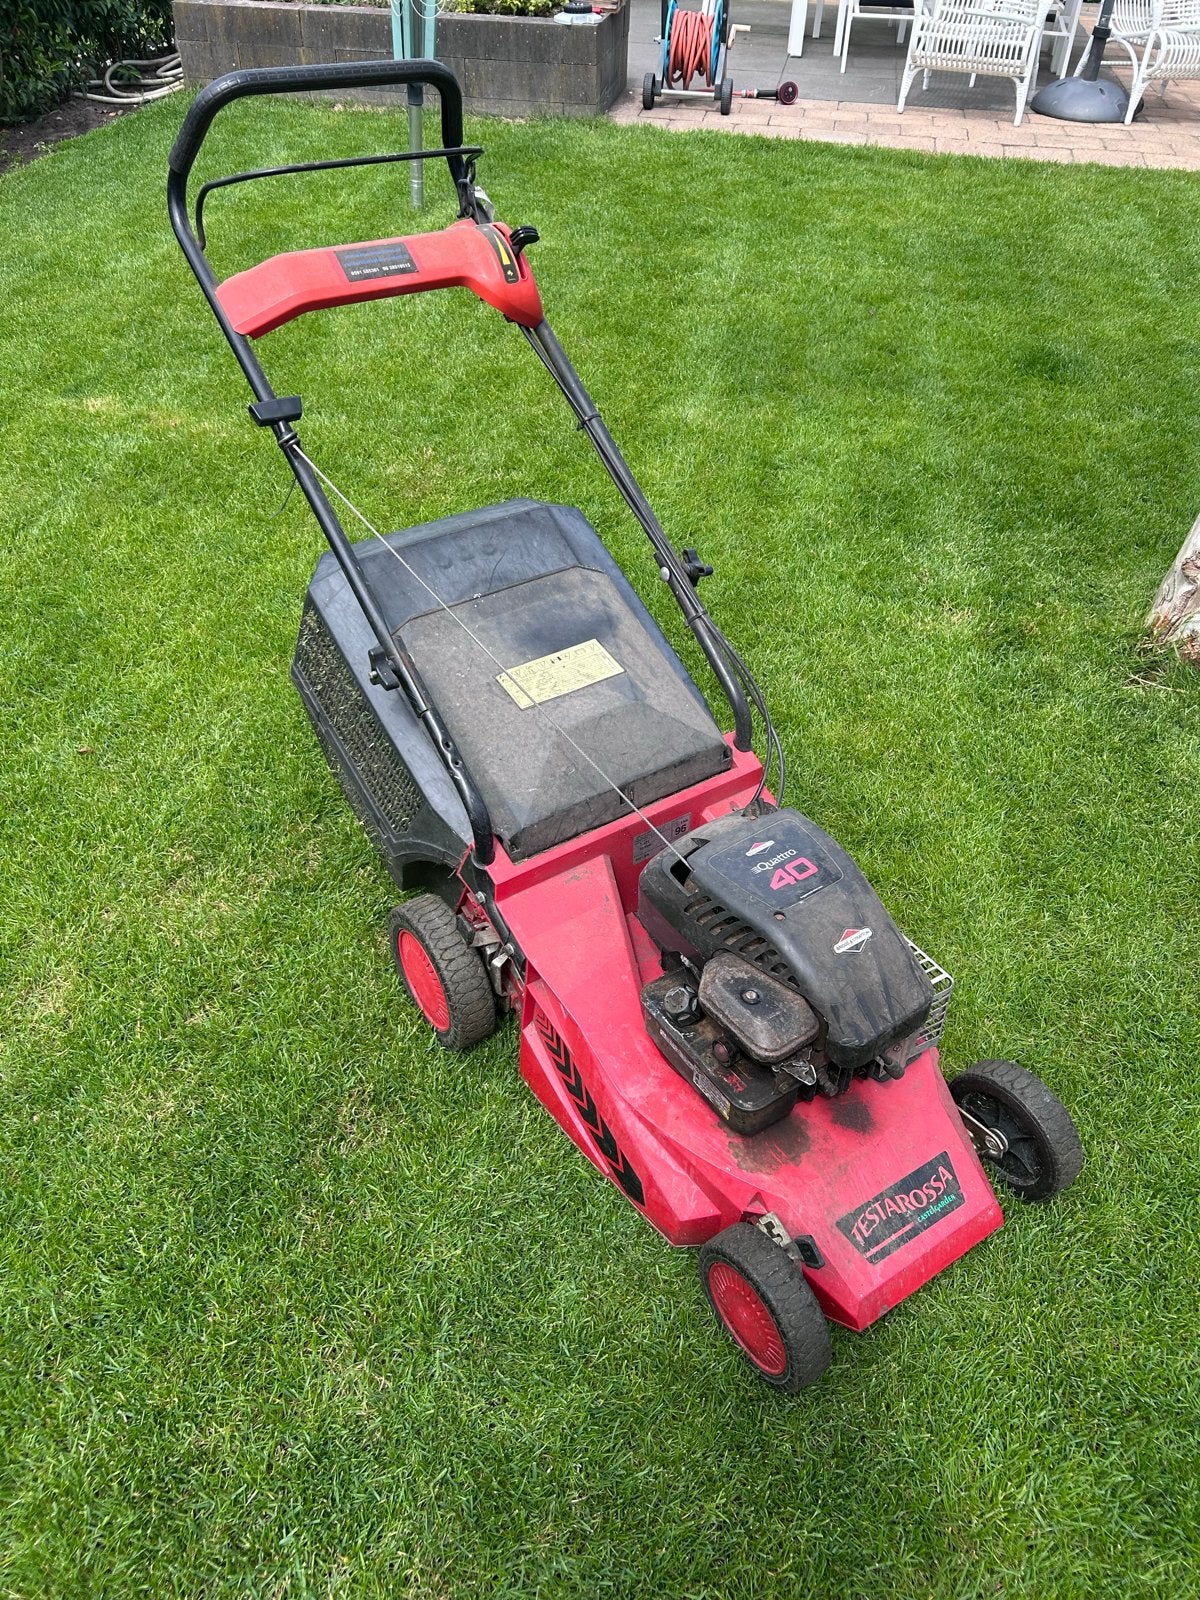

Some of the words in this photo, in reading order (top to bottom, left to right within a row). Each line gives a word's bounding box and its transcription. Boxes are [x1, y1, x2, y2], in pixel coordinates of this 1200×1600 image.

[675, 824, 687, 836] 96
[752, 849, 797, 874] Quattro
[769, 856, 819, 891] 40
[851, 1165, 953, 1247] TESTAROSSA
